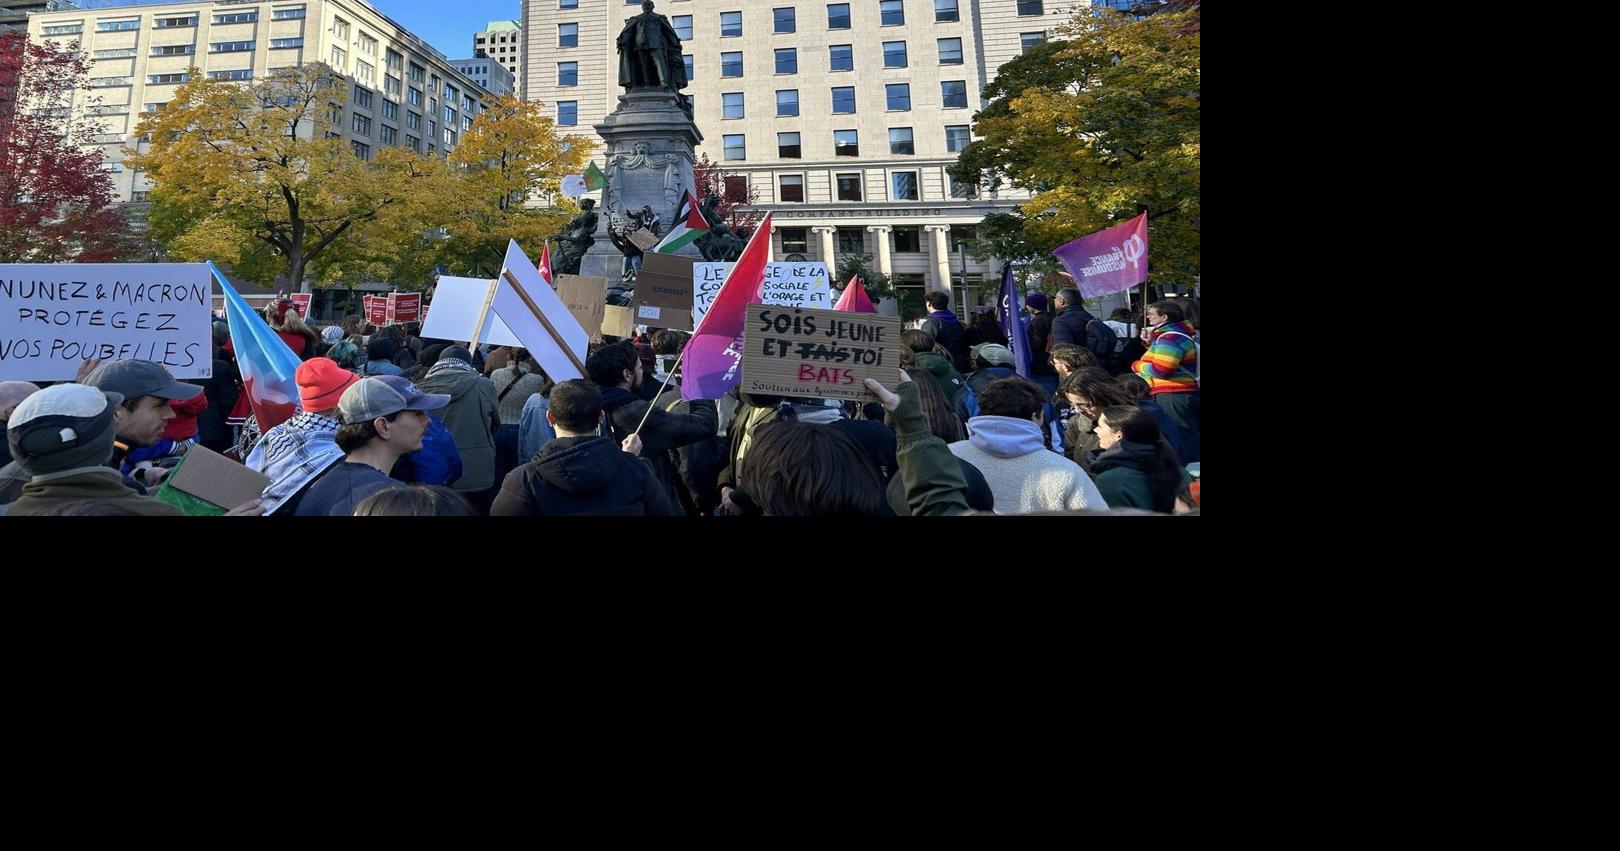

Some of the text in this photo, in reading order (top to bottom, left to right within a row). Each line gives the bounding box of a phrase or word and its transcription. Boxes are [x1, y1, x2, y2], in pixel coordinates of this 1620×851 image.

[866, 209, 942, 217] BUILDING
[704, 266, 825, 280] LE GE DE LA
[0, 280, 205, 306] NUNEZ & MACRON
[700, 281, 723, 292] CO
[695, 292, 826, 304] TO L'ORAGE ET
[19, 308, 179, 331] PROTÉGEZ
[825, 319, 887, 342] JEUNE
[0, 339, 199, 368] VOS POUBELLES
[763, 338, 792, 358] ET
[798, 364, 855, 384] BATS
